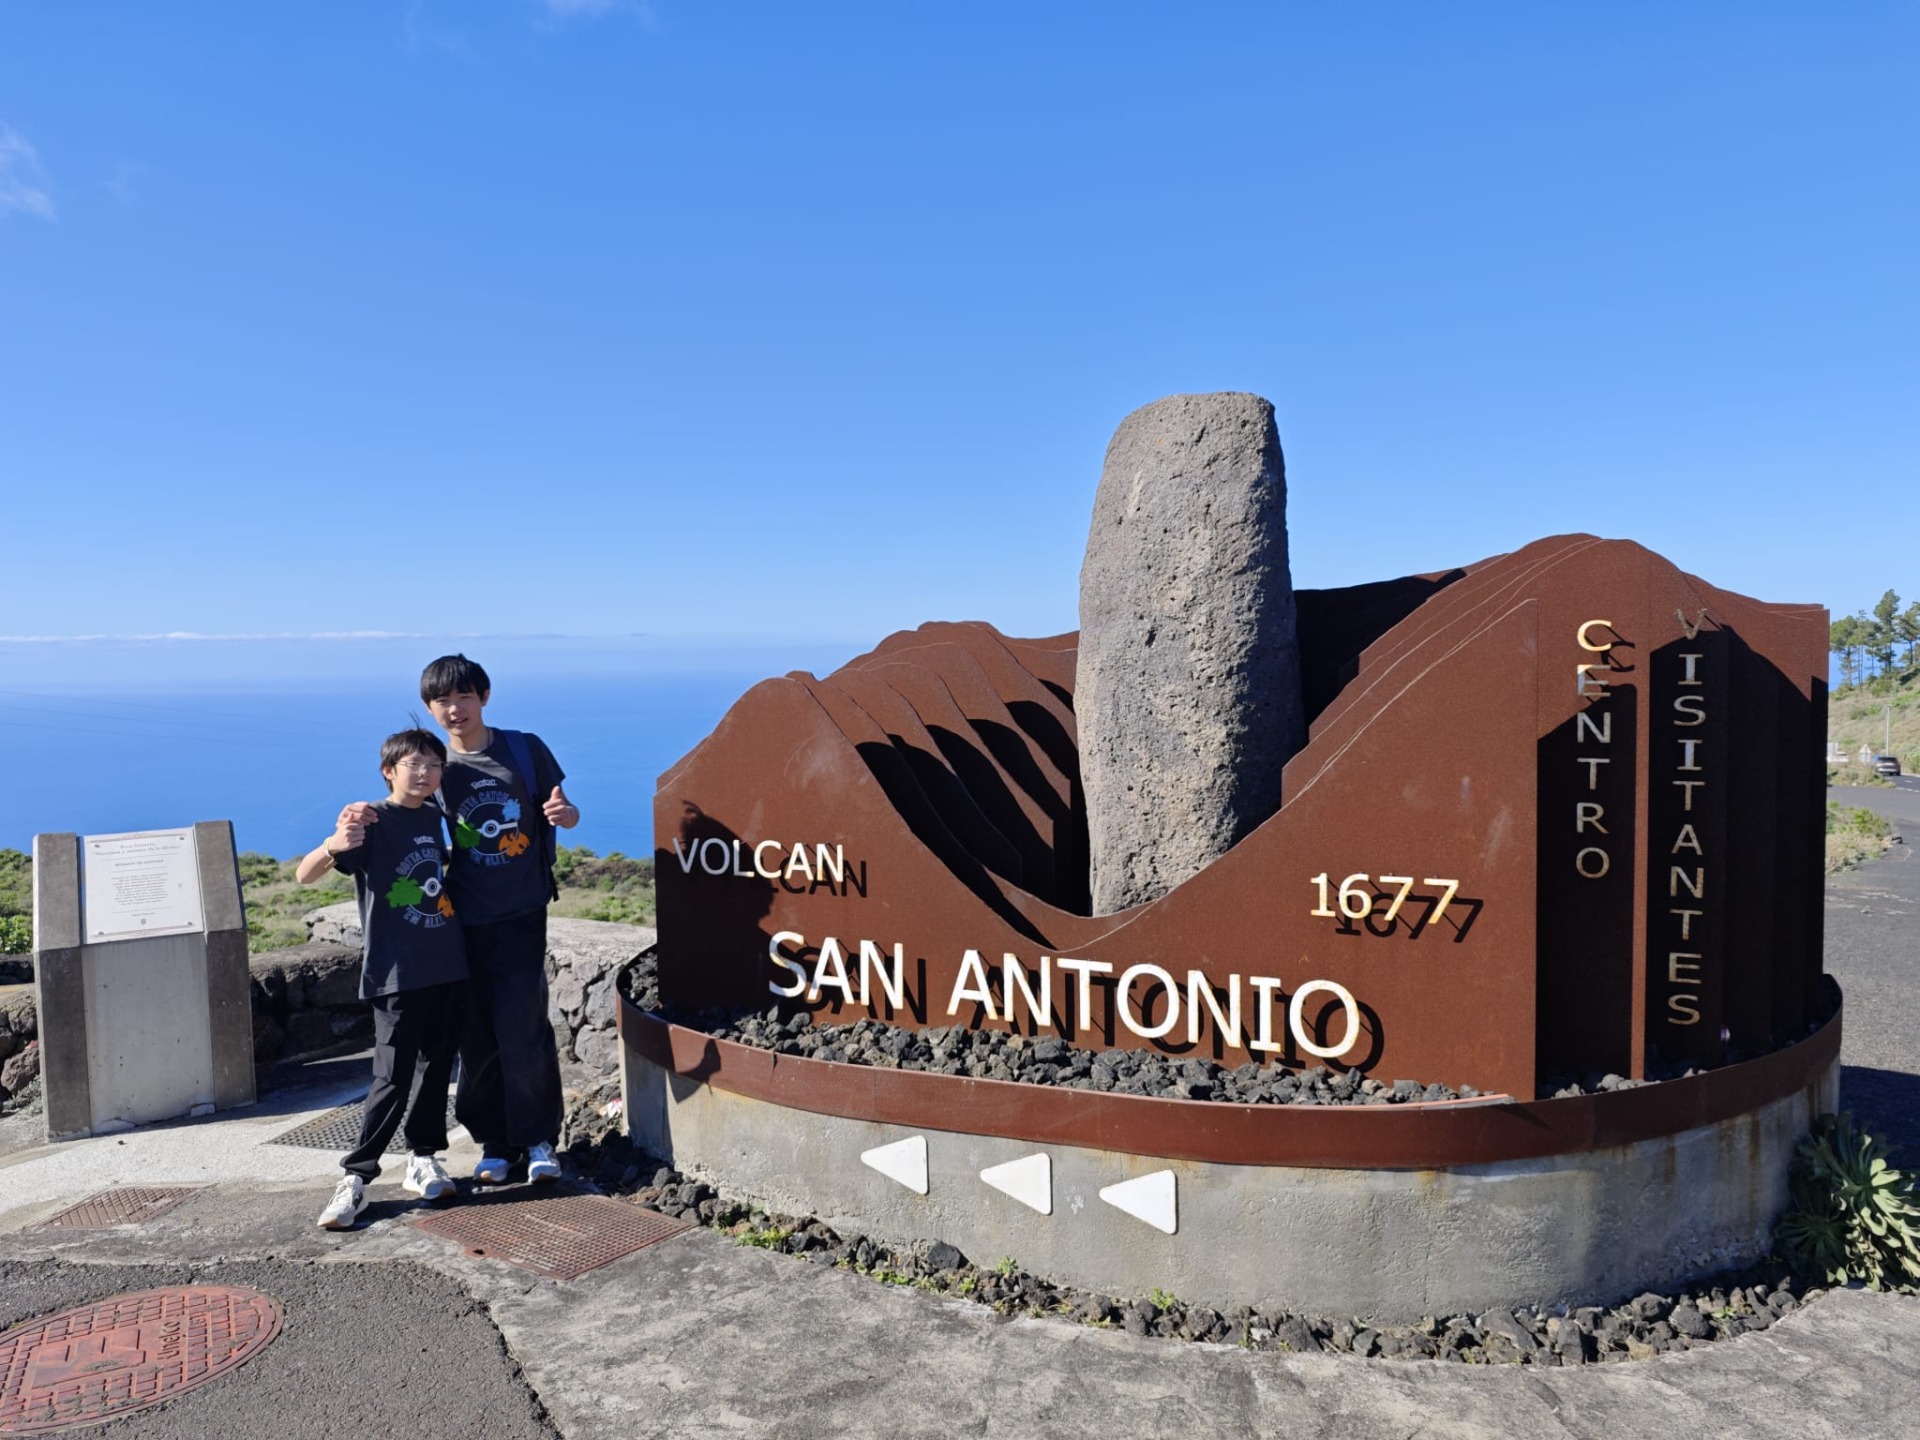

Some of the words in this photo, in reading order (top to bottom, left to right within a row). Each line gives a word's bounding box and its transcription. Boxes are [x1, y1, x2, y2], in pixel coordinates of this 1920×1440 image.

[1576, 619, 1612, 879] CENTRO
[672, 838, 844, 882] VOLCAN
[1667, 608, 1707, 1026] VISITANTES
[1310, 872, 1459, 924] 1677
[768, 930, 904, 1010] SAN
[946, 949, 1361, 1058] ANTONIO
